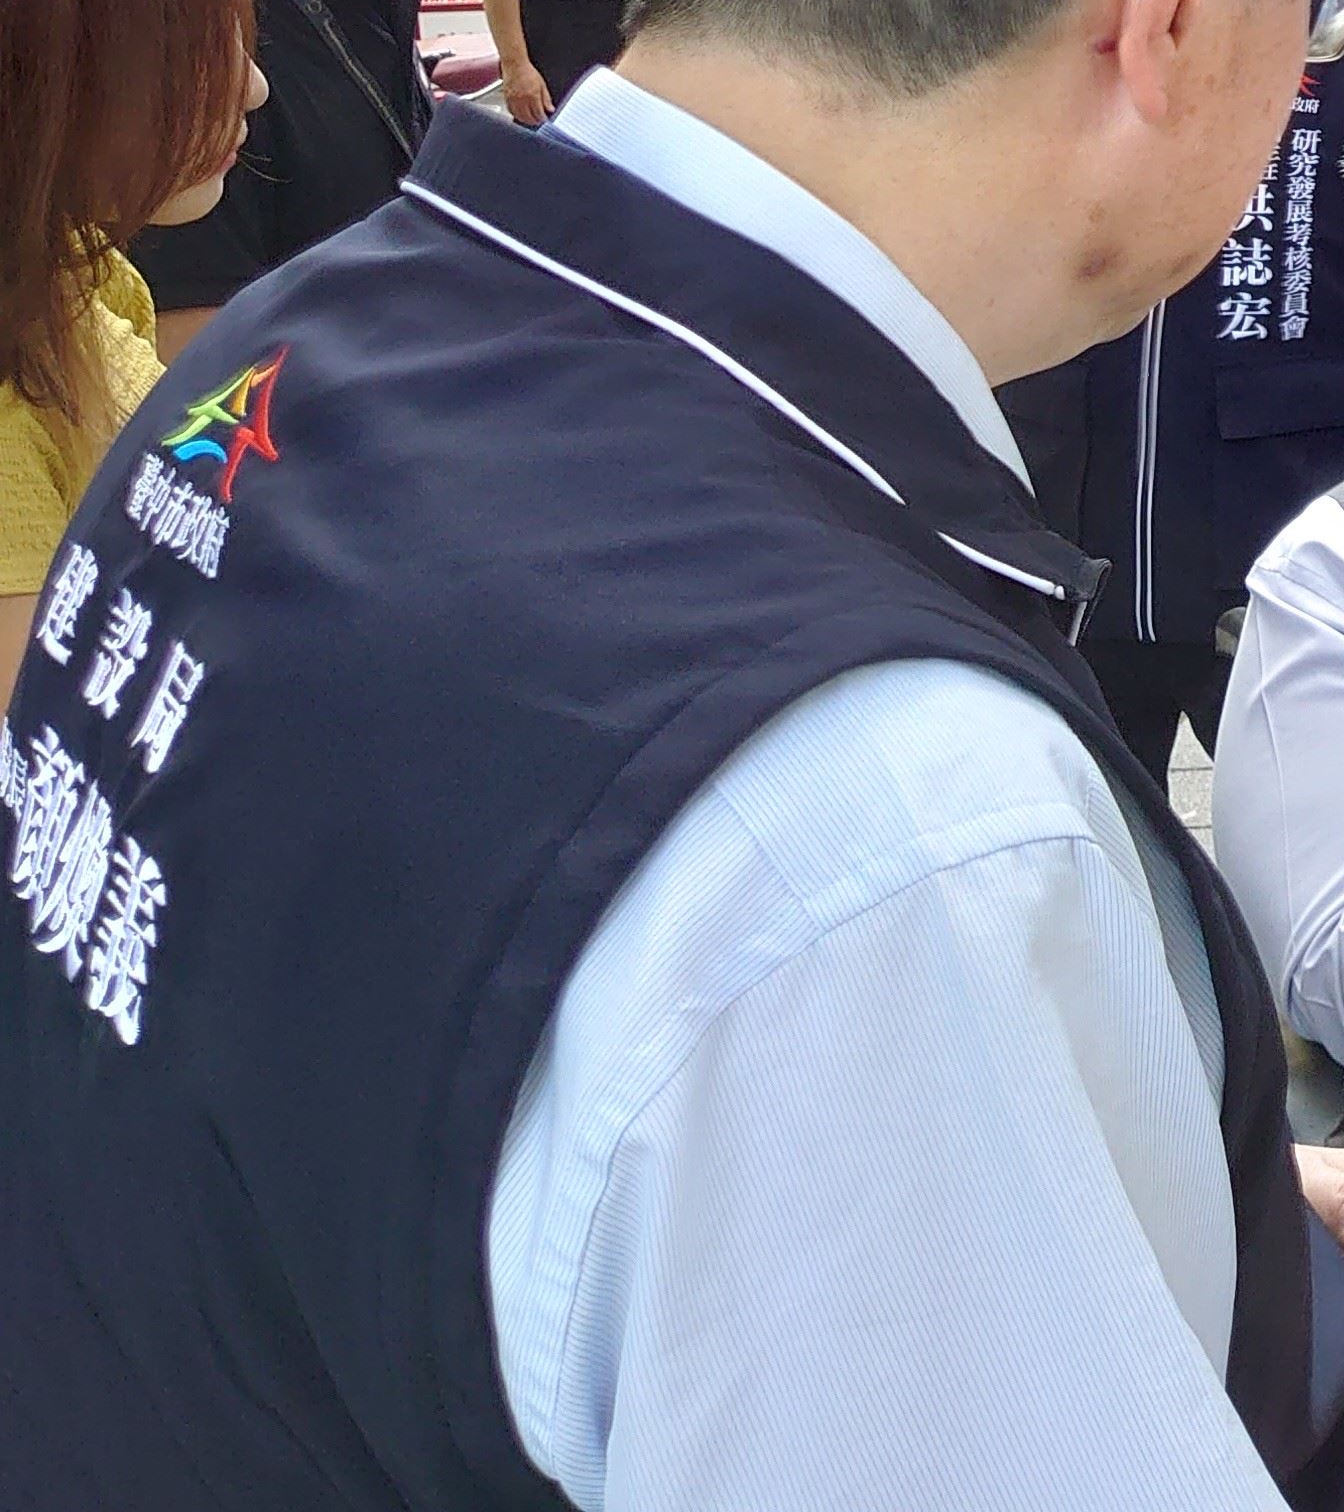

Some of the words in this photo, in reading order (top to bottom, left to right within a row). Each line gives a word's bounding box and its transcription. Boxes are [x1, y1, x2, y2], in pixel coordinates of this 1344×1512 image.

[1278, 127, 1322, 342] 研究發展考核委員會
[127, 451, 231, 579] 臺中市政府
[35, 541, 206, 775] 建設局
